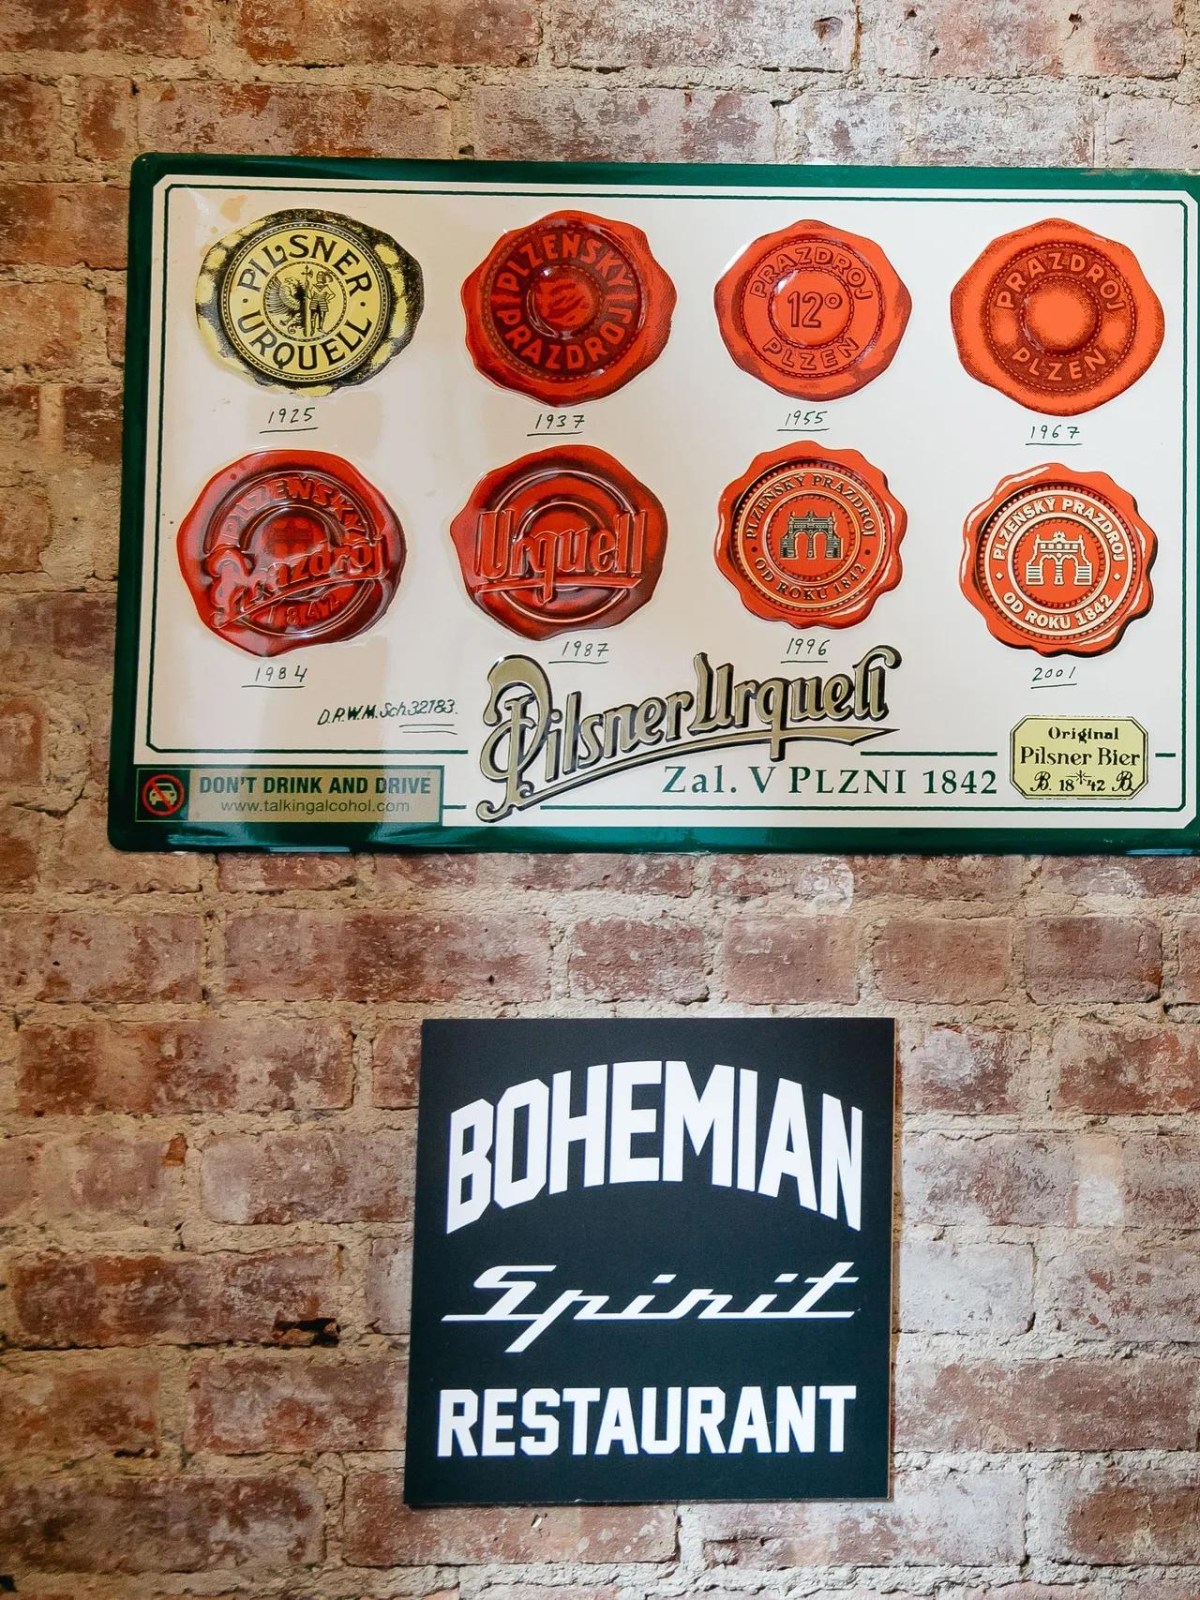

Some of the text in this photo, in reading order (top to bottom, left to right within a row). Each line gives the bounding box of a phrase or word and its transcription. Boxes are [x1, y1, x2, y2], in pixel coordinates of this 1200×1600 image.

[237, 234, 372, 296] PILSNER
[749, 246, 873, 301] PRAZDROJ
[996, 252, 1125, 310] PRAZDROJ
[237, 309, 373, 371] URQUELL
[496, 306, 633, 370] PRAZDROJ
[267, 407, 316, 425] 1925
[535, 413, 586, 430] 1937
[784, 409, 829, 426] 1955
[1030, 424, 1081, 440] 1967
[812, 473, 877, 538] PRAZDROJ
[1062, 497, 1126, 562] PRAZDROJ
[474, 508, 647, 605] Urquell
[754, 556, 867, 601] OD ROKU 1842
[1003, 591, 1113, 630] OD ROKU 1842
[561, 641, 610, 658] 1987
[786, 637, 831, 657] 1996
[254, 665, 308, 683] 1984
[1032, 666, 1077, 682] 2001
[476, 645, 903, 823] Pilsner Urquell
[1048, 726, 1119, 744] Original
[1020, 745, 1141, 767] Pilsner Bier
[199, 776, 431, 795] DON'T DRINK AND DRIVE
[662, 764, 998, 795] Zal. V PLZNI 1842
[221, 799, 410, 816] www.talkingalcohol.com
[446, 1060, 863, 1235] BOHEMIAN
[441, 1261, 860, 1353] Spirit
[436, 1384, 857, 1458] RESTAURANT
